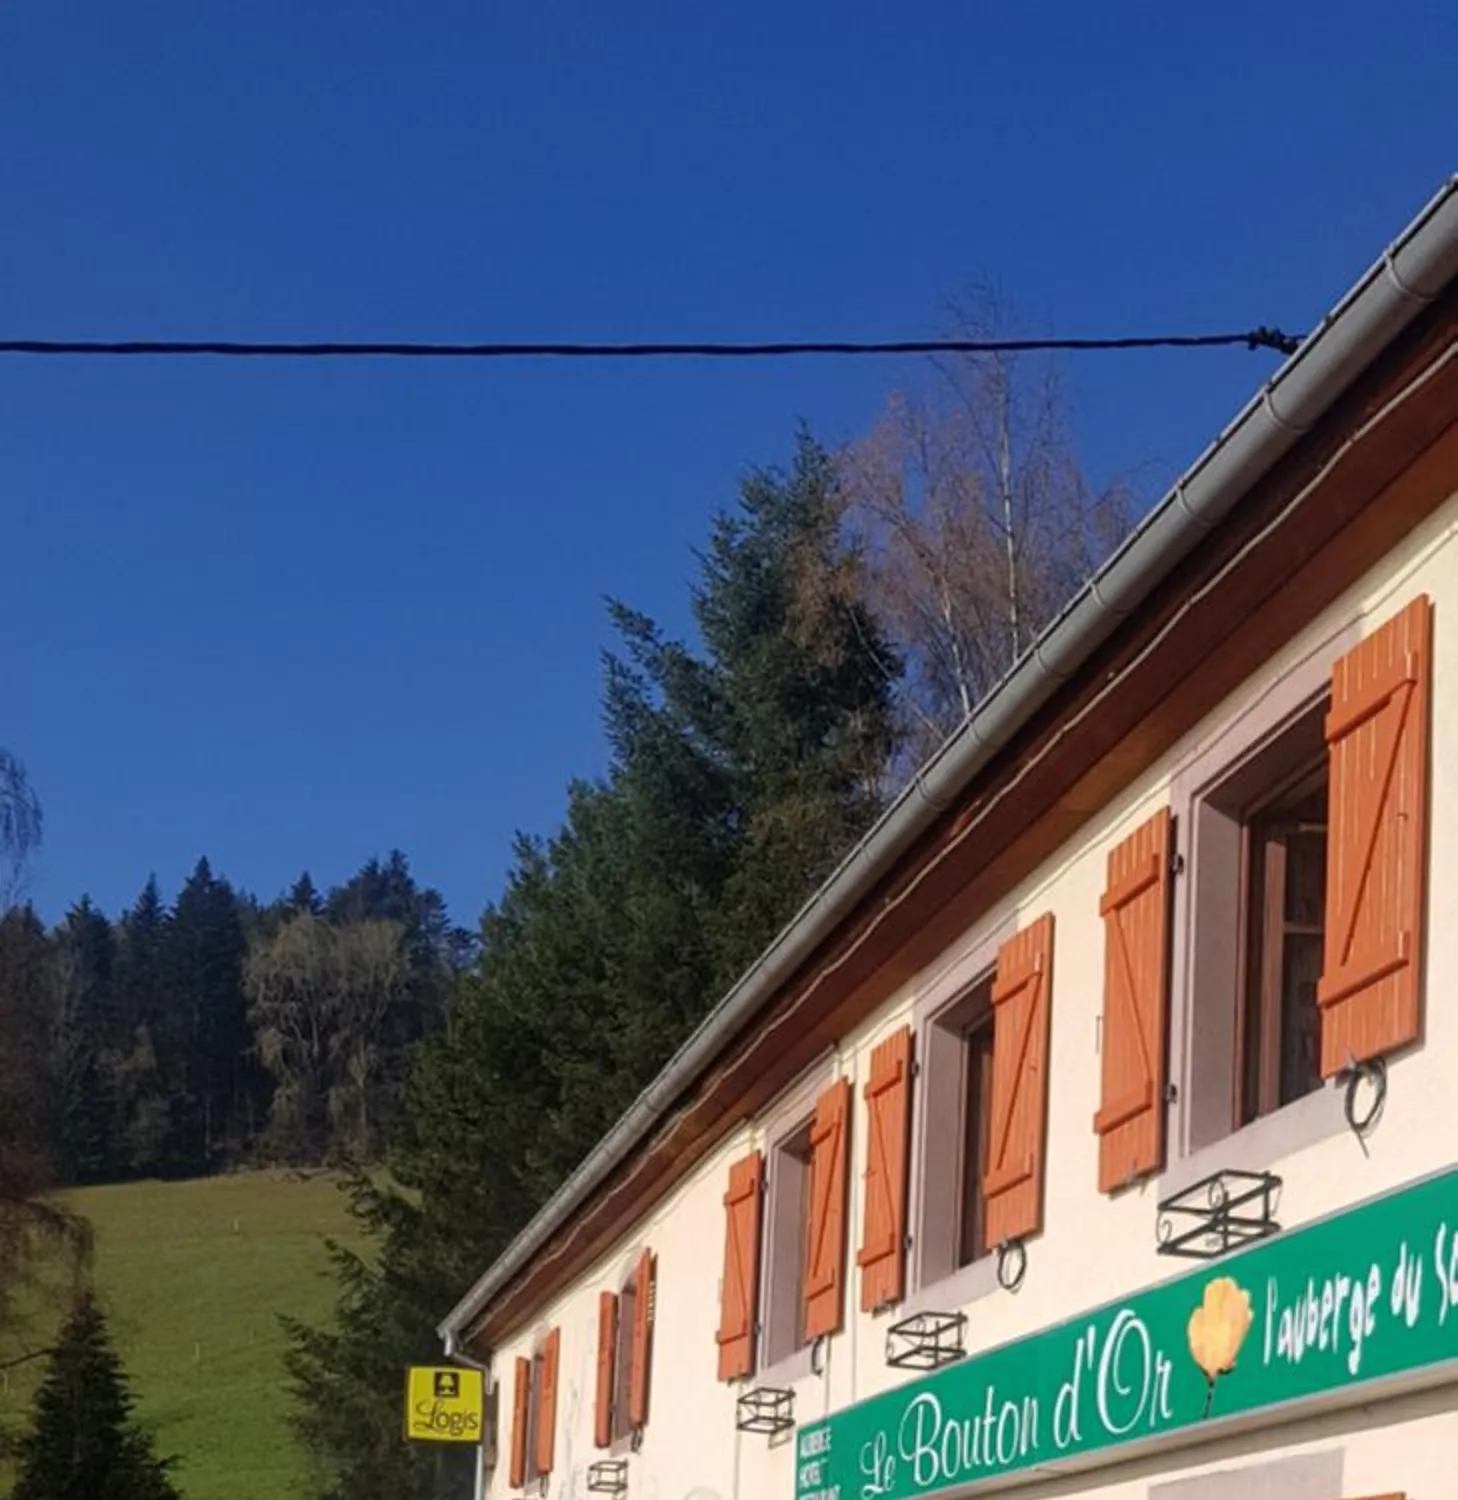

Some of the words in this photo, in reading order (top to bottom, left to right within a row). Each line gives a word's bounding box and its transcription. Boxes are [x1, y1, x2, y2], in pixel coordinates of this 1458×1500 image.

[1263, 1262, 1381, 1375] l'auberge
[1391, 1240, 1423, 1327] du
[413, 1399, 479, 1437] Logis
[860, 1430, 896, 1500] Le
[898, 1391, 1039, 1486] Bouton
[1053, 1309, 1173, 1449] d'Or
